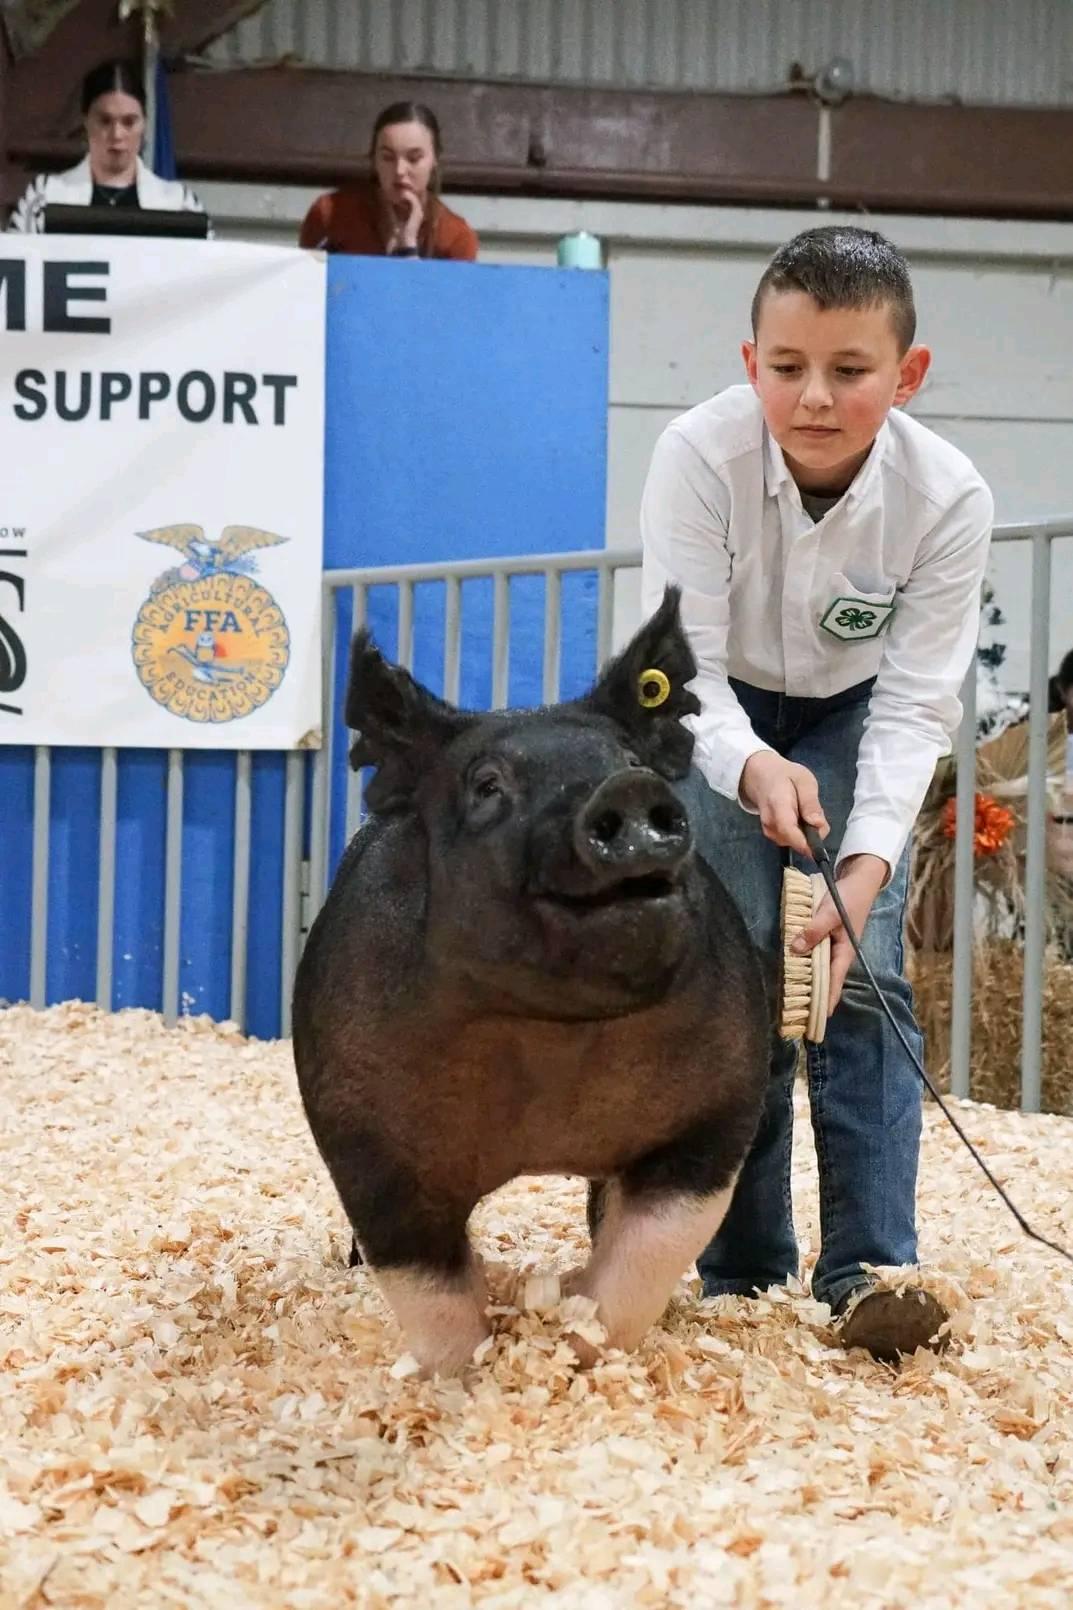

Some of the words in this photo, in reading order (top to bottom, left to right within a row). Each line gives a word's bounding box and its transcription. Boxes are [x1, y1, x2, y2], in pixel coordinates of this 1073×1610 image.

[13, 368, 298, 426] SUPPORT
[159, 590, 264, 637] AGRICULTURAL
[184, 610, 242, 632] FFA
[166, 671, 256, 701] EDUCATION
